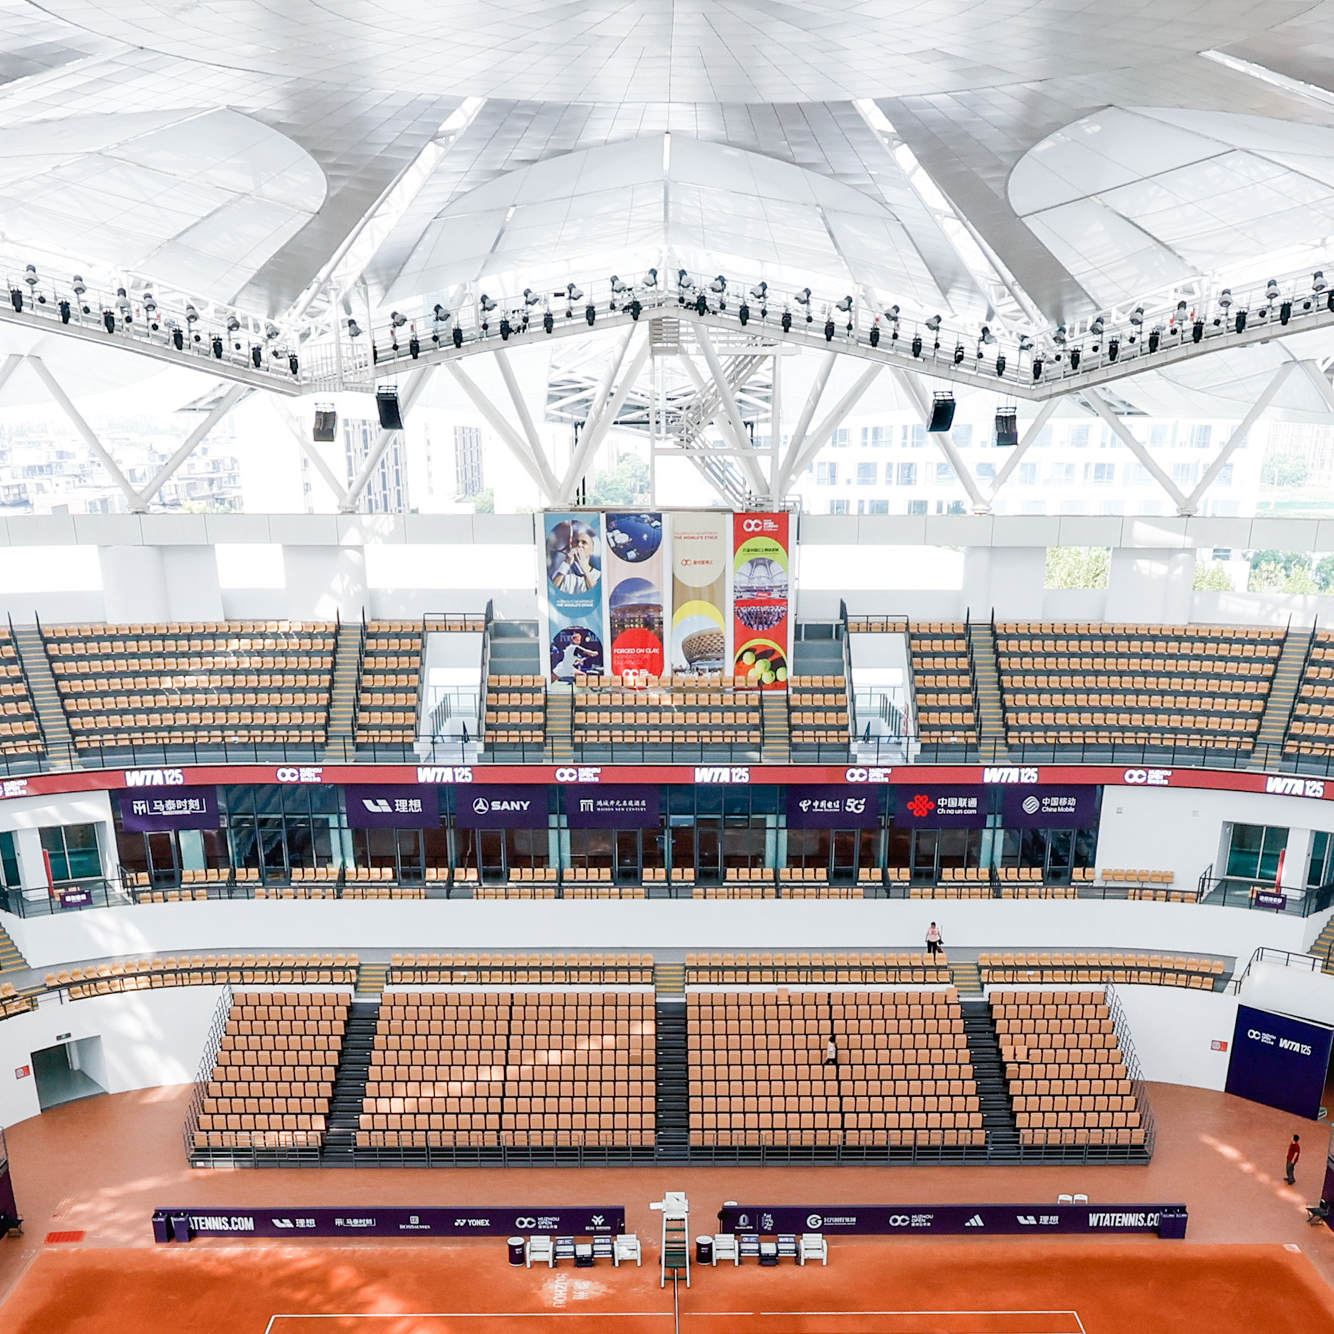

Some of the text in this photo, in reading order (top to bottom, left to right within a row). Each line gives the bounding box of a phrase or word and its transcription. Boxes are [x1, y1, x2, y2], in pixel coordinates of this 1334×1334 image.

[395, 799, 422, 812] 理想
[490, 801, 530, 811] SANY
[812, 800, 840, 809] 中国电信
[845, 798, 866, 813] 5G
[937, 798, 977, 808] 中国联通
[1042, 797, 1076, 806] 中国移动
[296, 1217, 316, 1228] 理想
[467, 1219, 491, 1227] YONEX
[1039, 1216, 1059, 1225] 理想
[1088, 1213, 1160, 1227] WTATENNIS.CO
